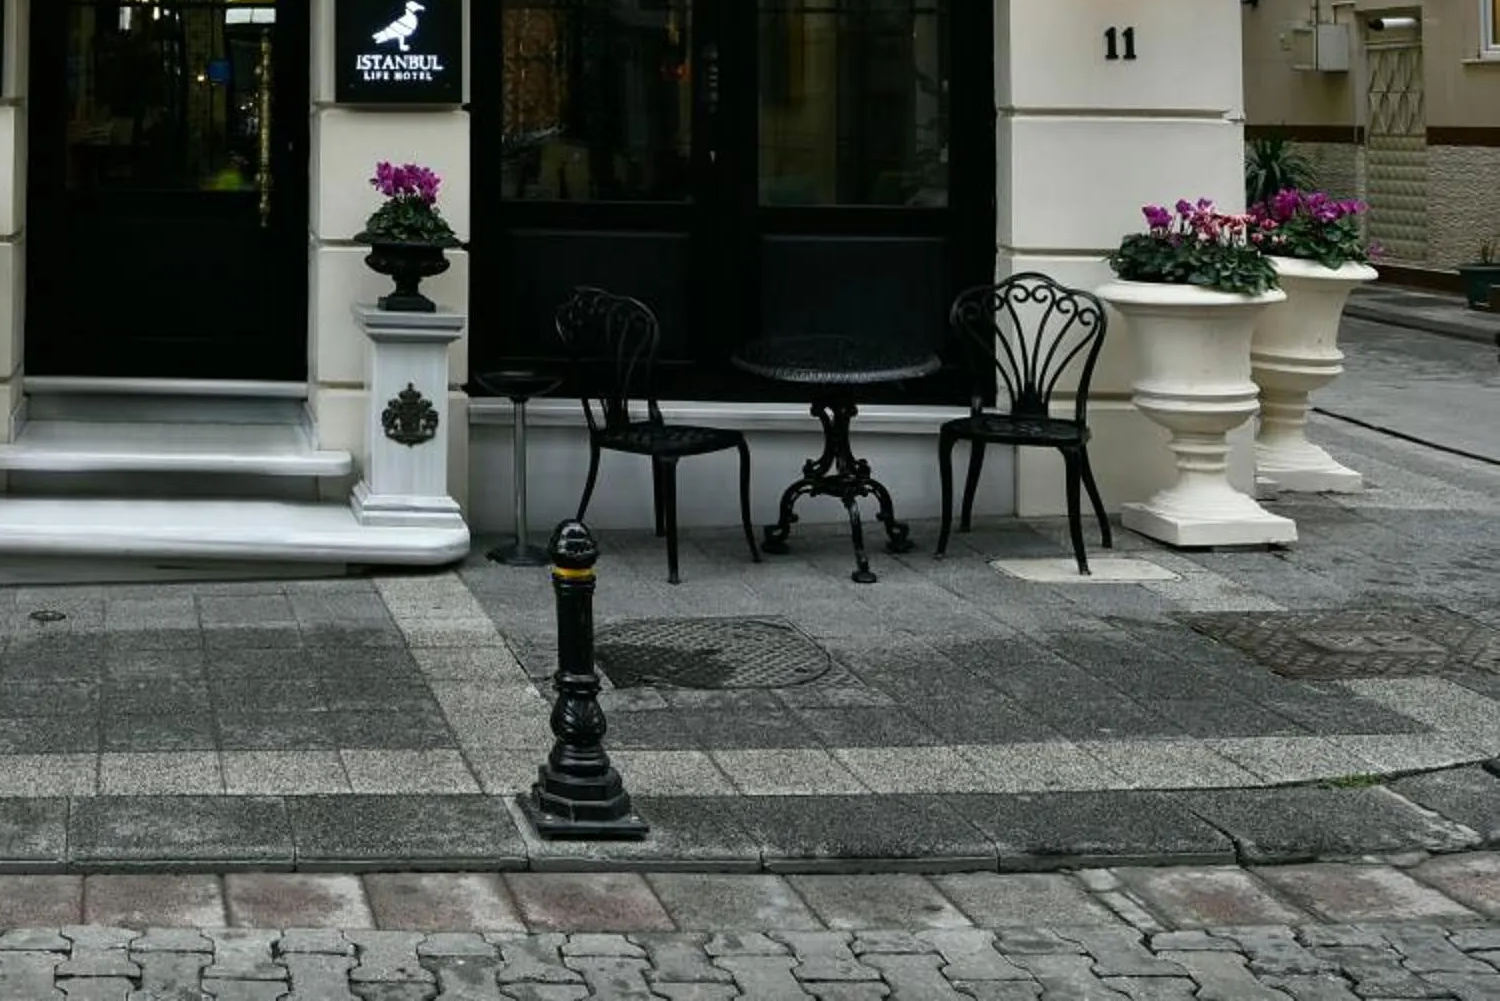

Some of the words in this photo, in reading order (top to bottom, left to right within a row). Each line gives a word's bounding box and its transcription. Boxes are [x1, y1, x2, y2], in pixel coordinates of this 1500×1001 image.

[1104, 26, 1137, 60] 11
[363, 71, 390, 81] LIFE
[393, 71, 433, 81] HOTEL
